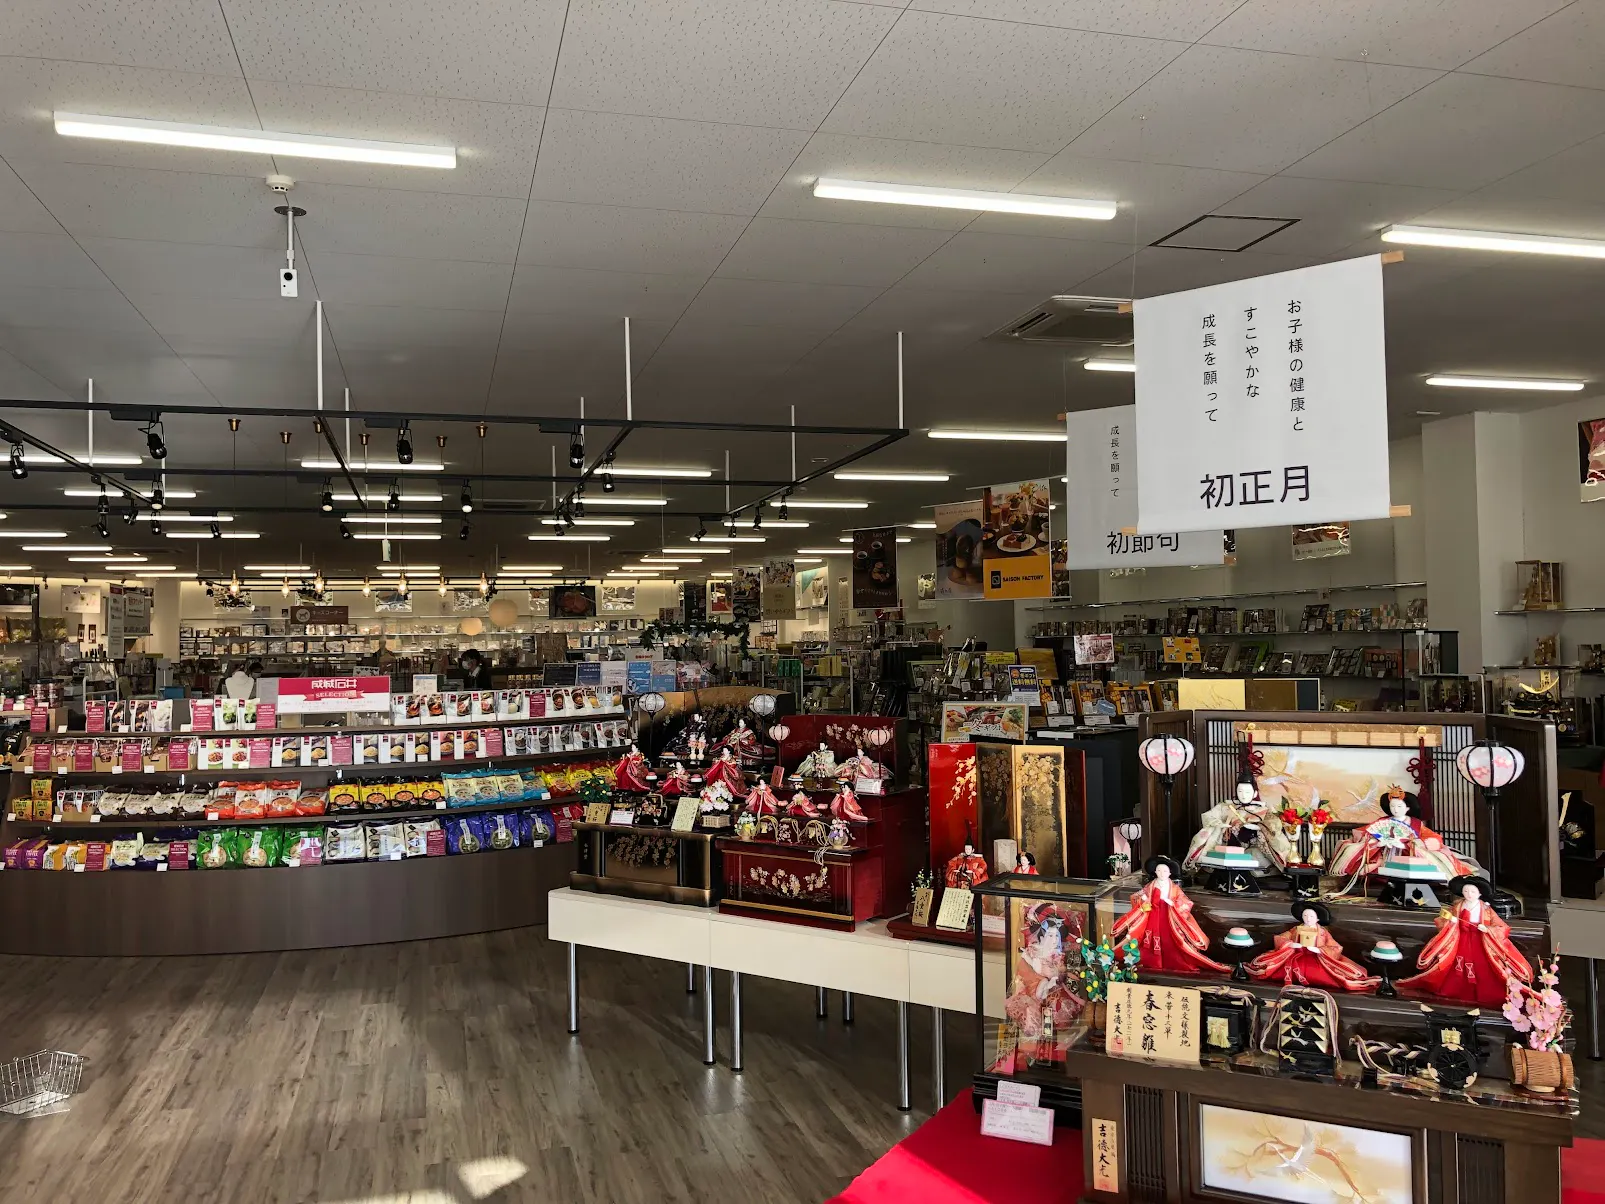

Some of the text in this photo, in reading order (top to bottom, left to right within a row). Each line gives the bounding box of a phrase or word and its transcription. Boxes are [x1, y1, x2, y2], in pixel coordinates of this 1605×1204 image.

[1201, 313, 1219, 422] 成長を願って
[1243, 306, 1260, 399] すこやかな
[1287, 299, 1306, 432] お子様の健康と
[1110, 425, 1120, 498] 成長を願って
[1200, 465, 1310, 509] 初正月
[311, 679, 357, 689] 成城石井
